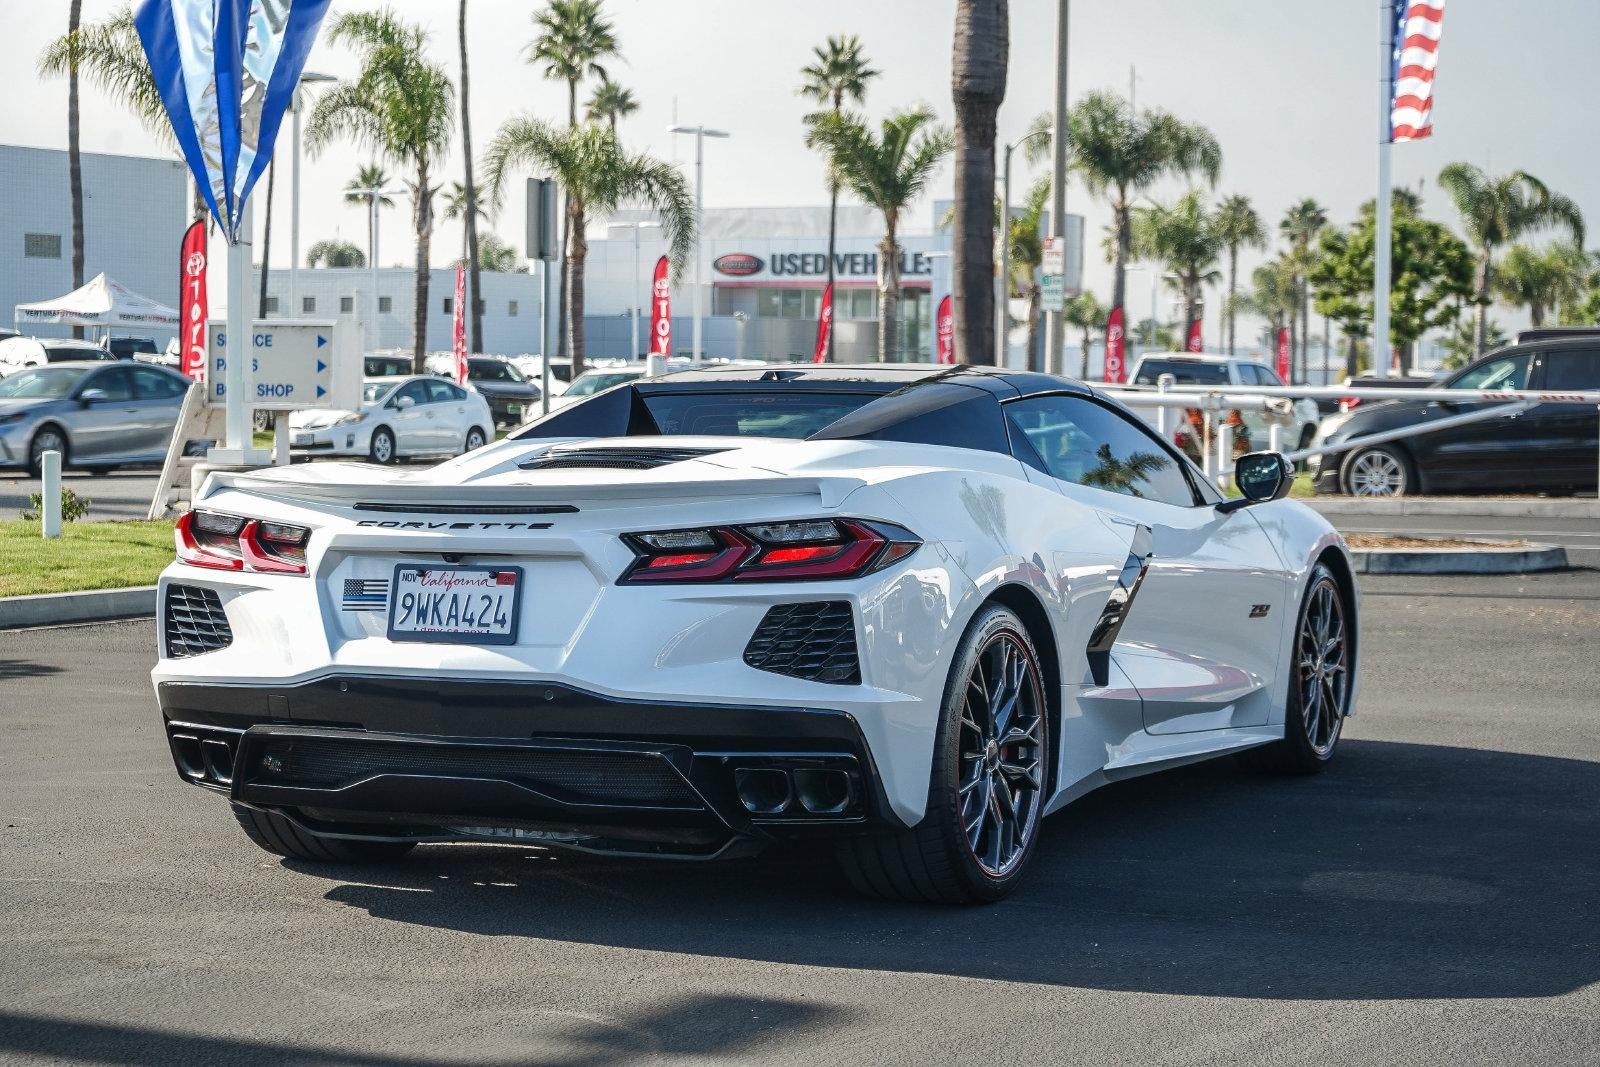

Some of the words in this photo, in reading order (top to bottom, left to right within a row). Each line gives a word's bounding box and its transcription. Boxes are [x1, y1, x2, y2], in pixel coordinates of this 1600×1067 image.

[771, 253, 827, 275] USED
[257, 384, 294, 397] SHOP
[356, 520, 555, 530] CORVETTE
[402, 572, 417, 583] NOV
[420, 570, 496, 592] California
[398, 592, 507, 628] 9WKA424
